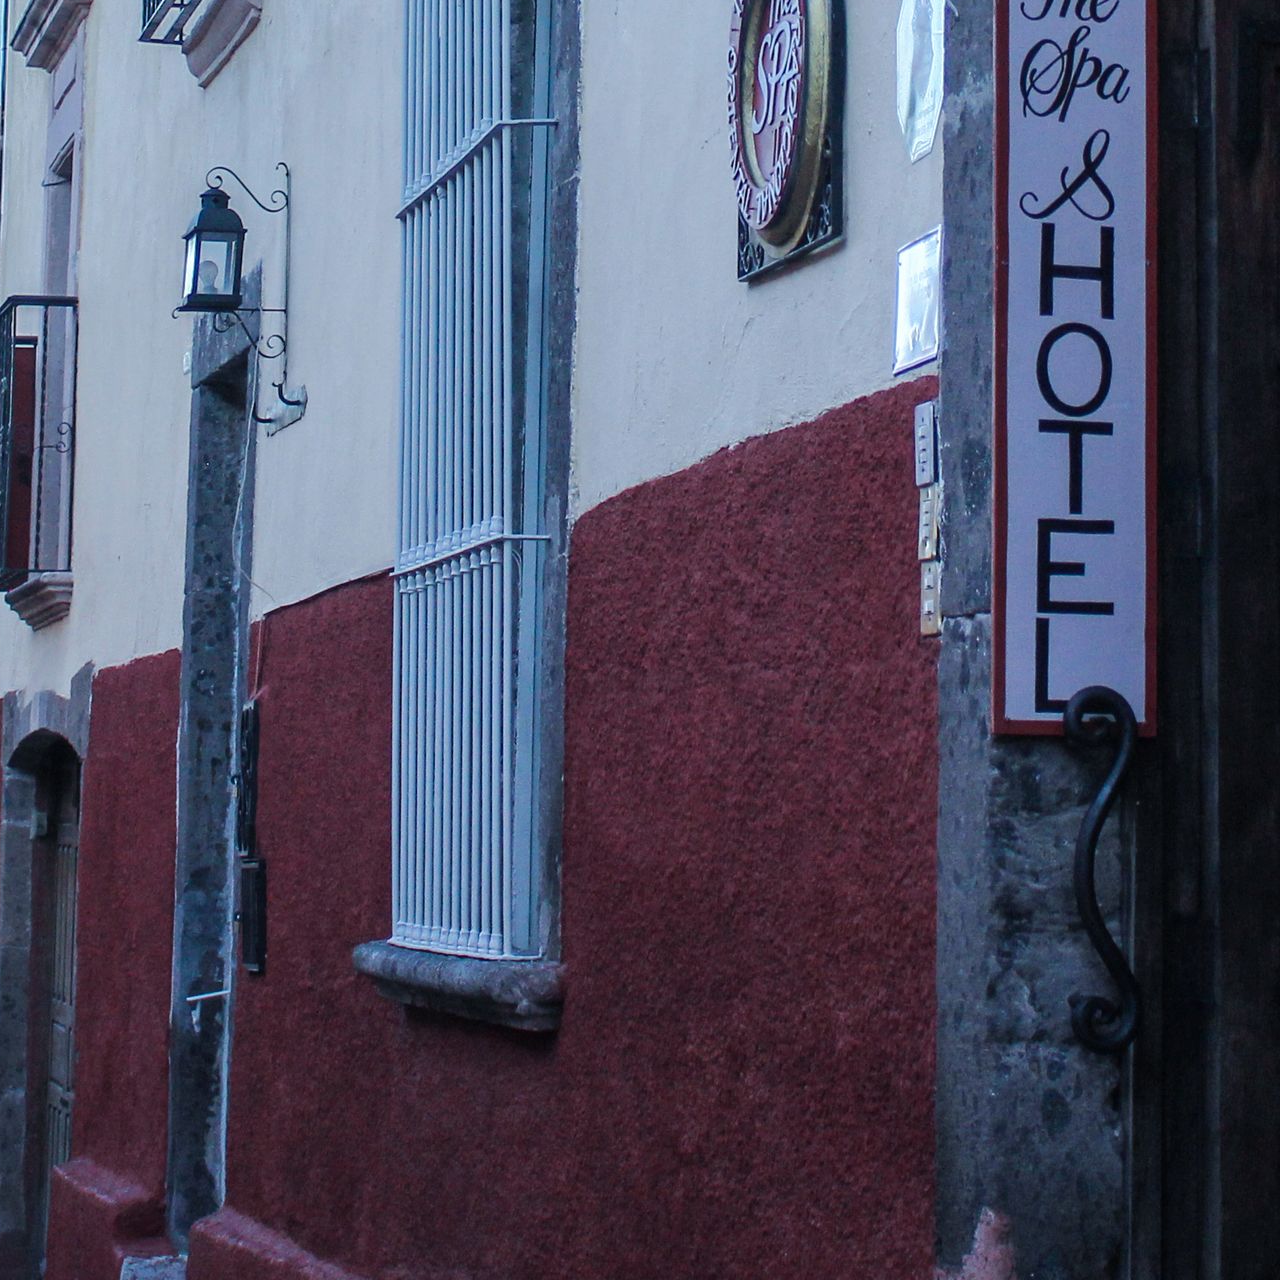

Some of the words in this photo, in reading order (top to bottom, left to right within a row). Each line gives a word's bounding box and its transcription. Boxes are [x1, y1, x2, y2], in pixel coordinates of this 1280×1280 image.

[751, 19, 799, 135] SPA
[1020, 25, 1132, 122] Spa
[1019, 128, 1115, 222] &
[1034, 223, 1115, 714] HOTEL
